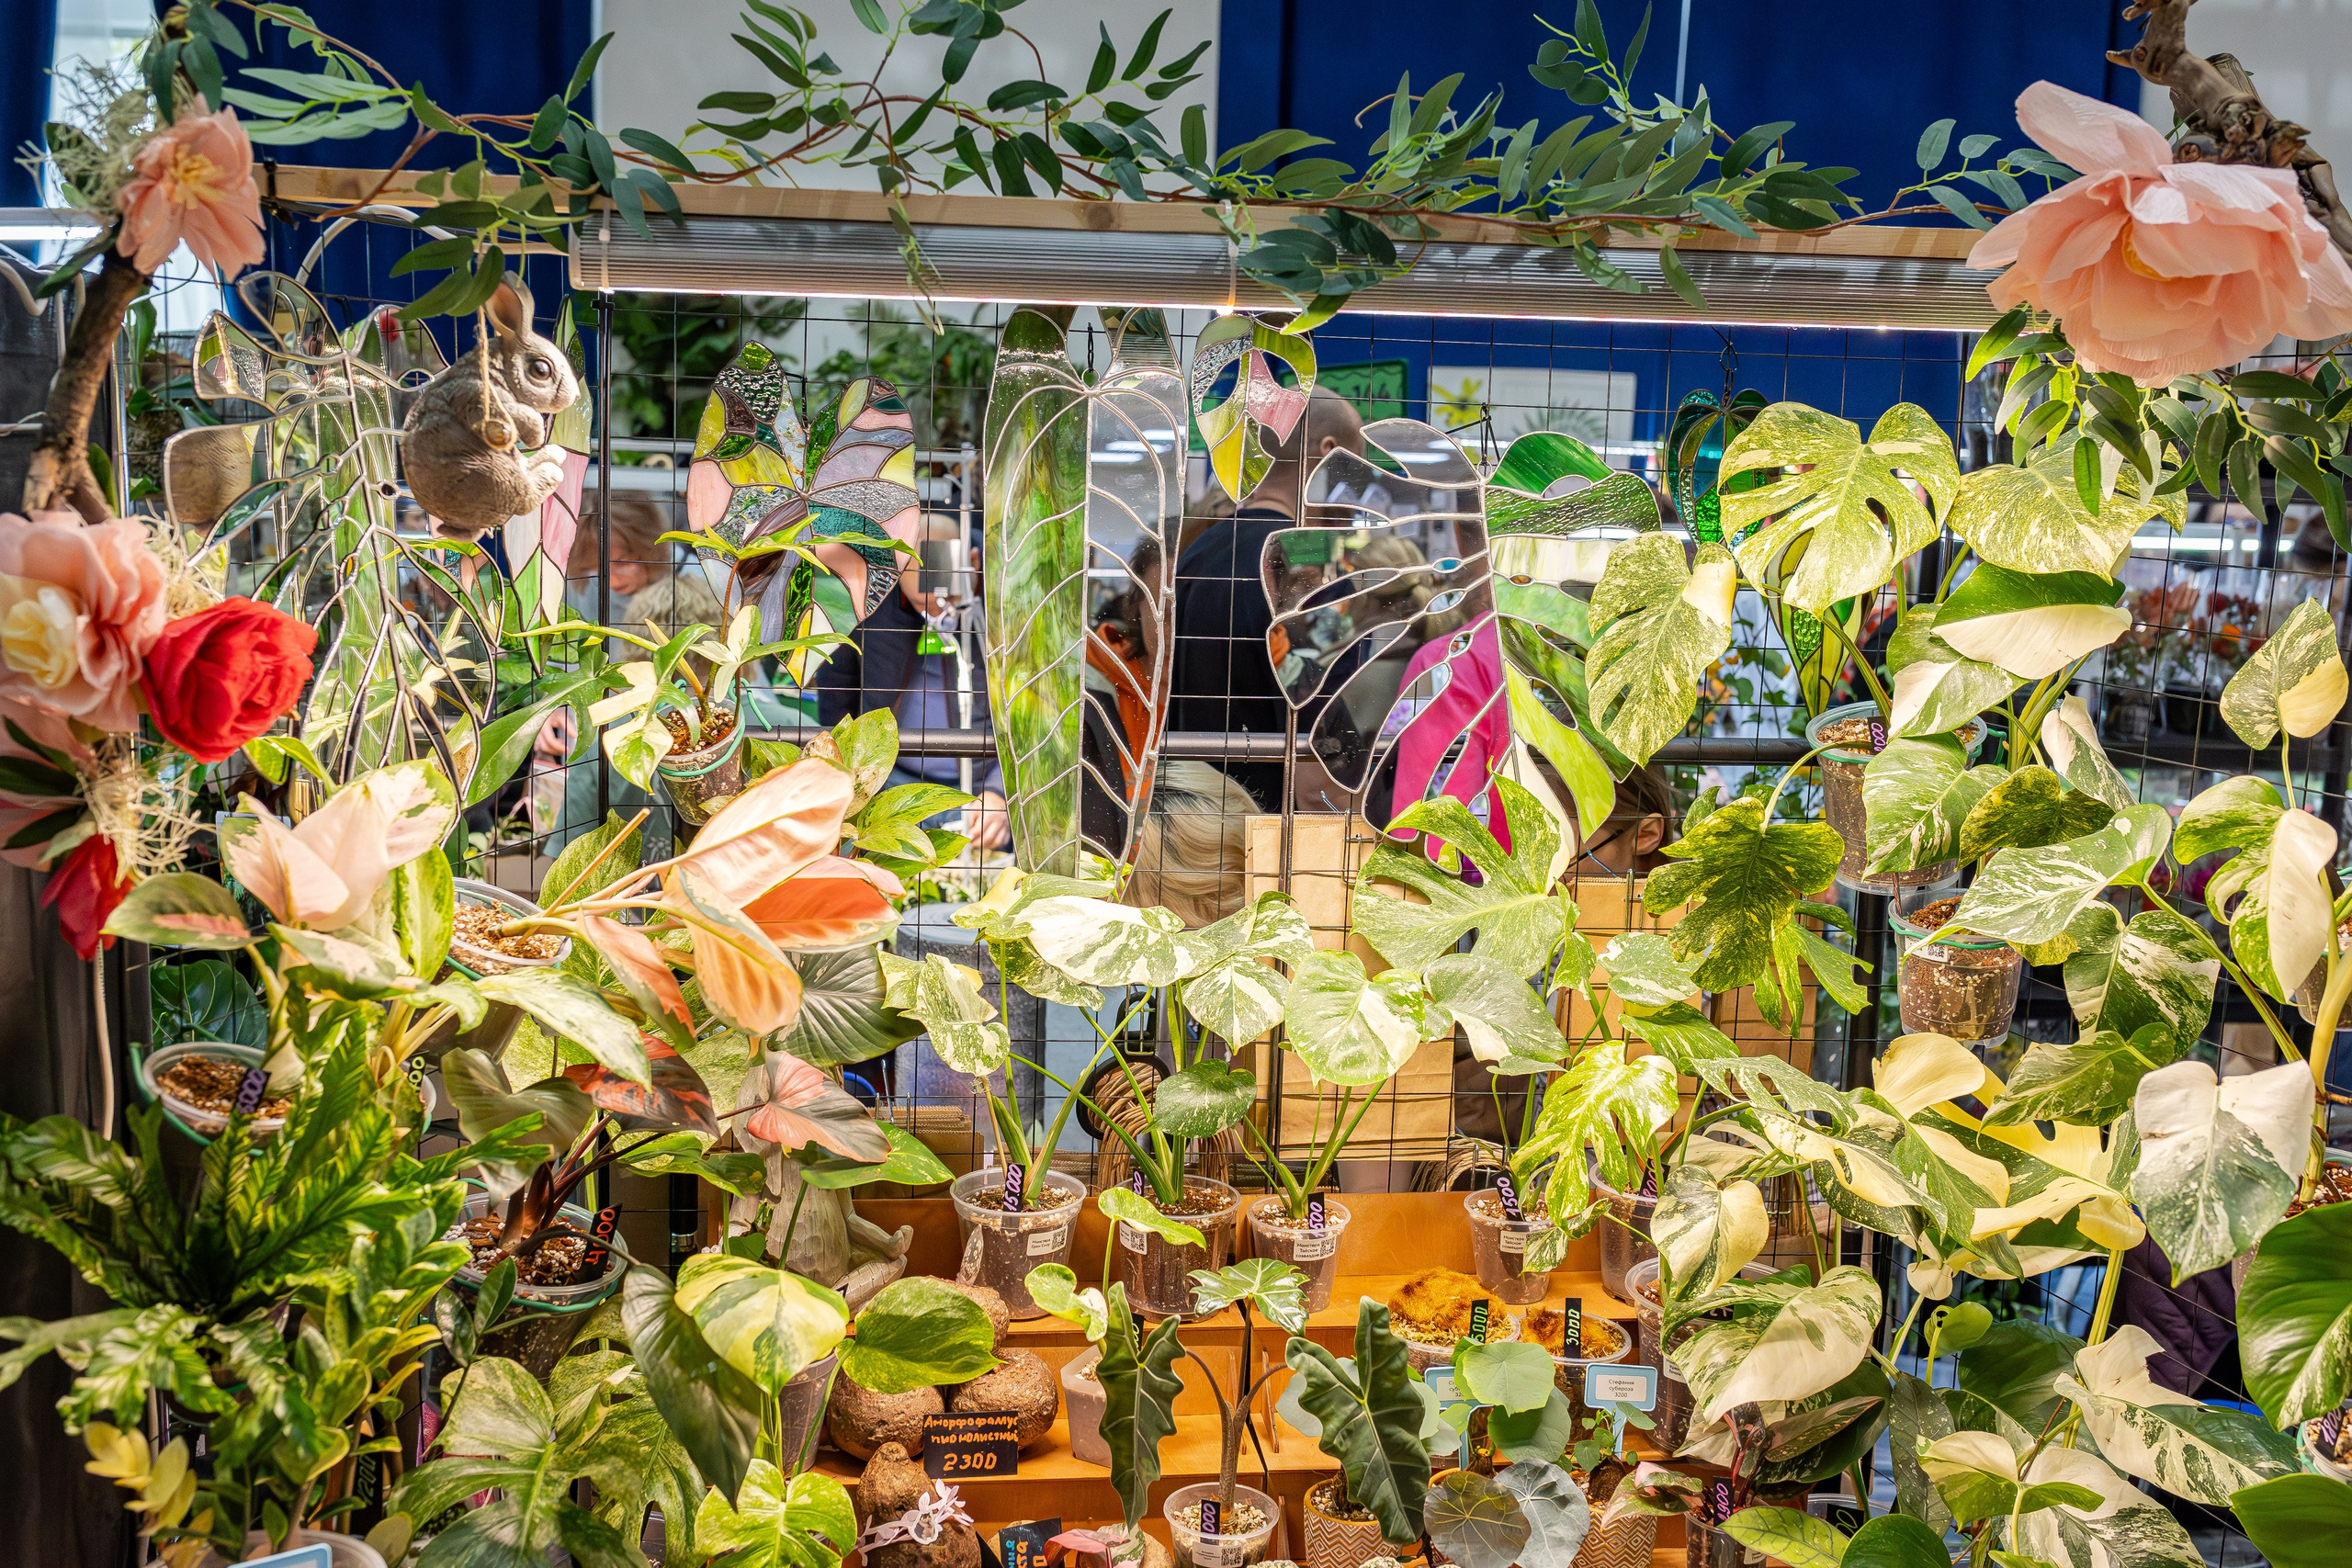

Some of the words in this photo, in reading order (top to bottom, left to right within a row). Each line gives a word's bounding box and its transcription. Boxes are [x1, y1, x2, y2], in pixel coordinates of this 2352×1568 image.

[1133, 1170, 1143, 1196] 00
[1497, 1177, 1521, 1218] 1500
[1566, 1308, 1580, 1347] 3000
[943, 1452, 998, 1472] 2300
